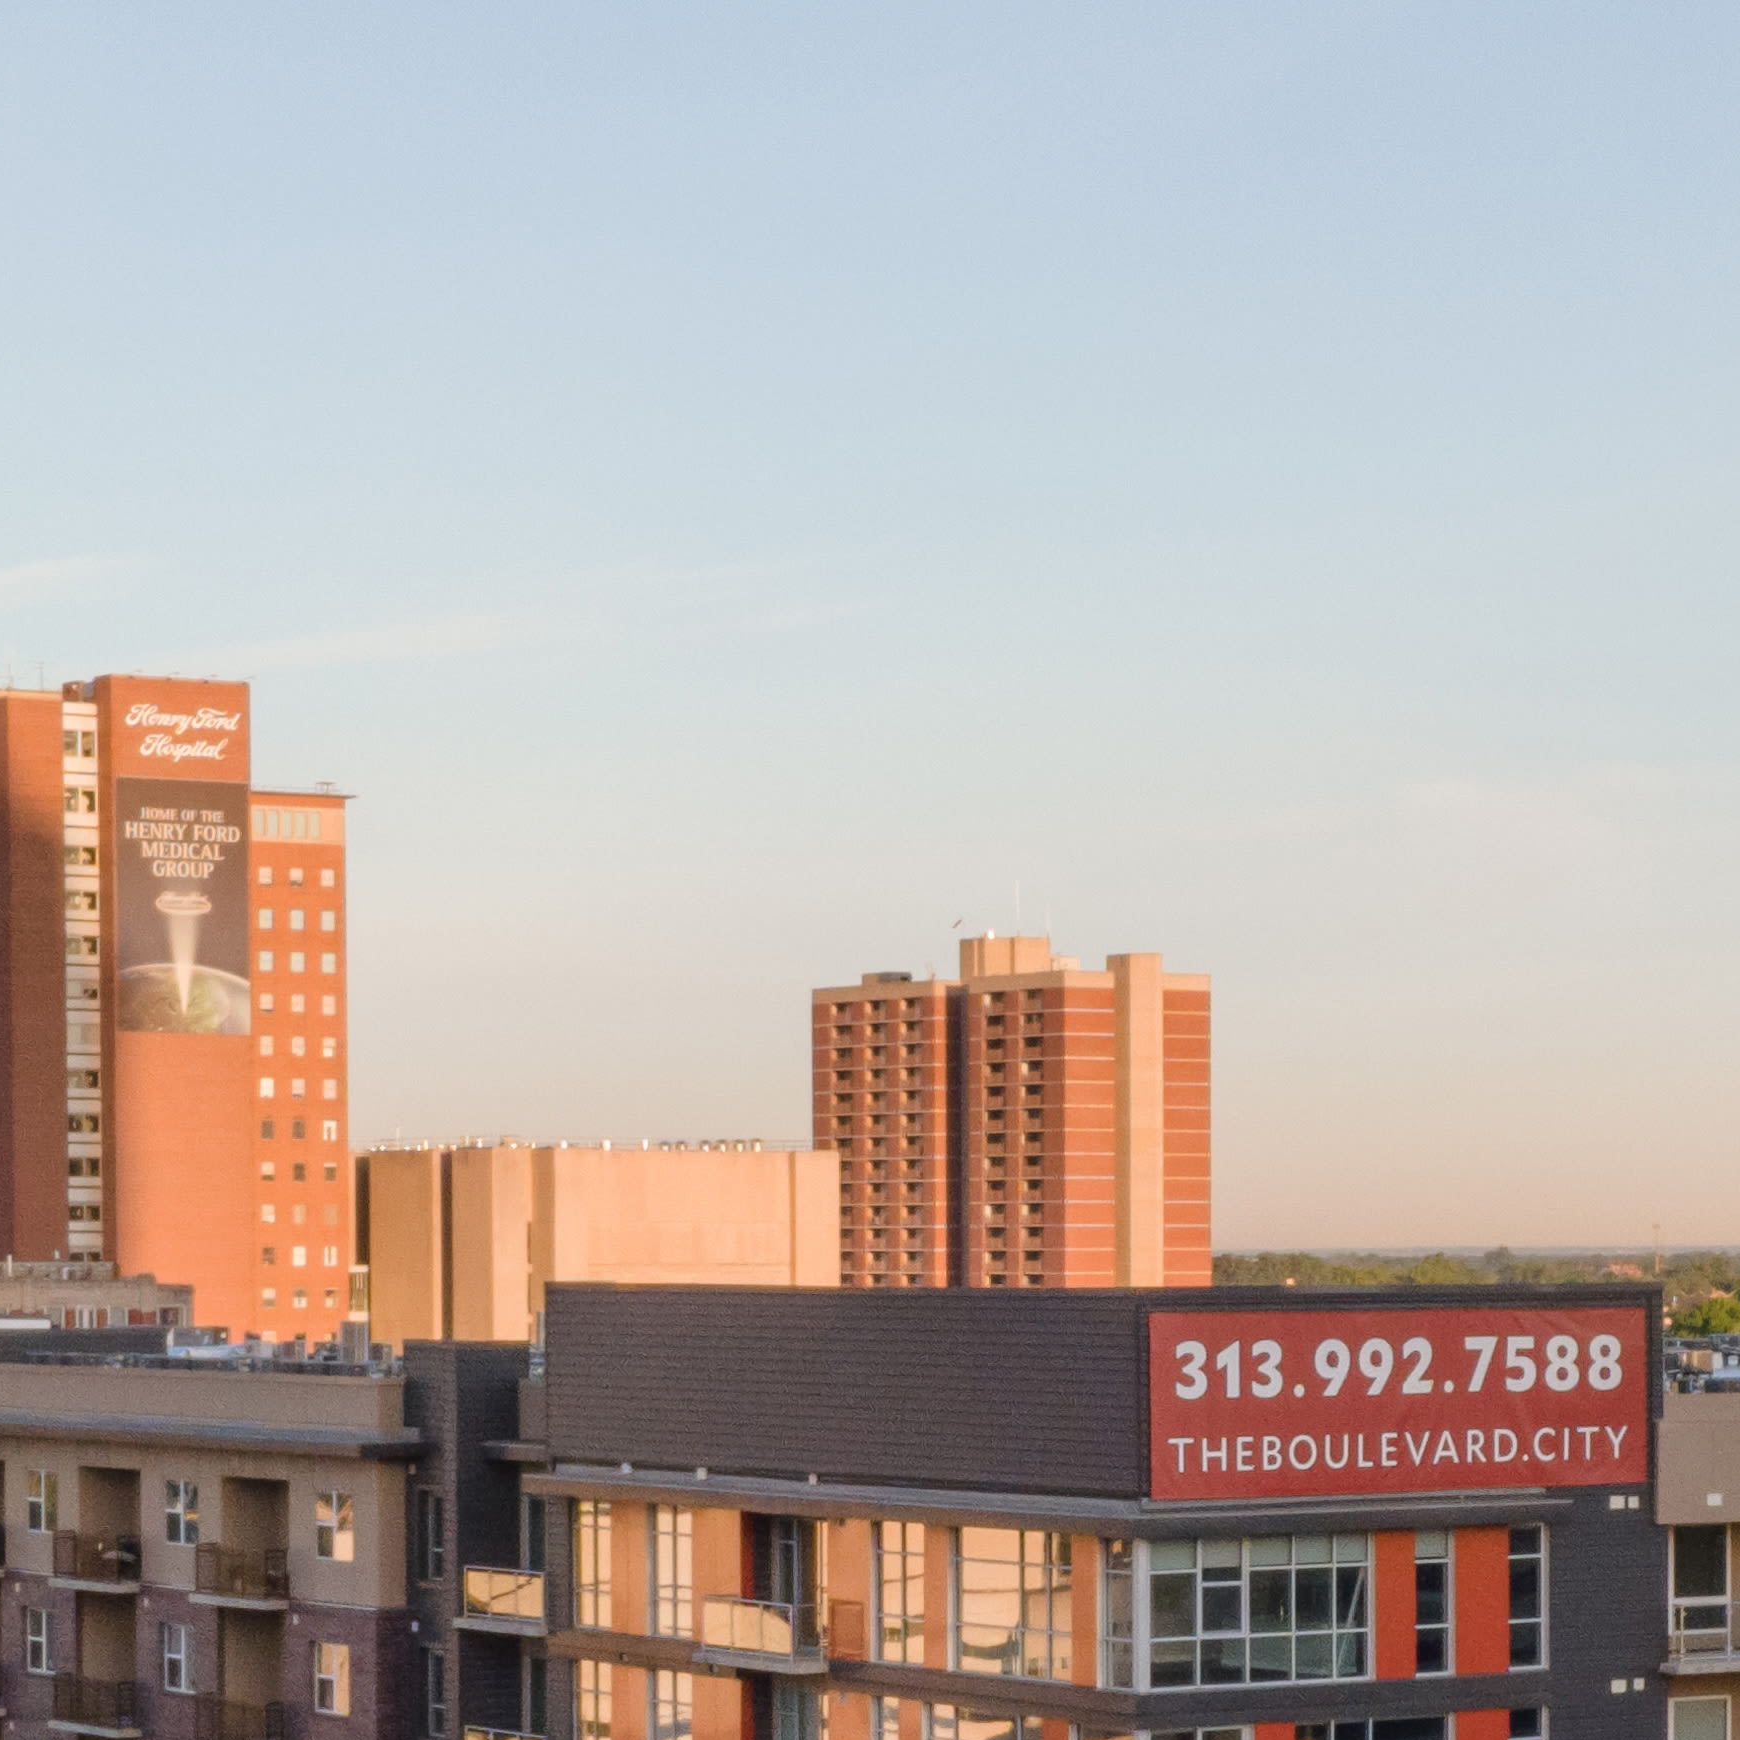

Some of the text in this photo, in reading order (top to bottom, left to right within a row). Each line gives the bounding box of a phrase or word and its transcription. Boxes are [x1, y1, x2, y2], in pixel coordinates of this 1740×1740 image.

[125, 704, 242, 735] Henry Ford
[140, 734, 229, 763] Hospital
[140, 807, 225, 823] HOME OF THE
[124, 821, 241, 843] HENRY FORD
[141, 841, 225, 861] MEDICAL
[152, 859, 215, 879] GROUP
[1174, 1334, 1623, 1400] 313.992.7588
[1167, 1425, 1628, 1473] THEBOULEVARD.CITY
